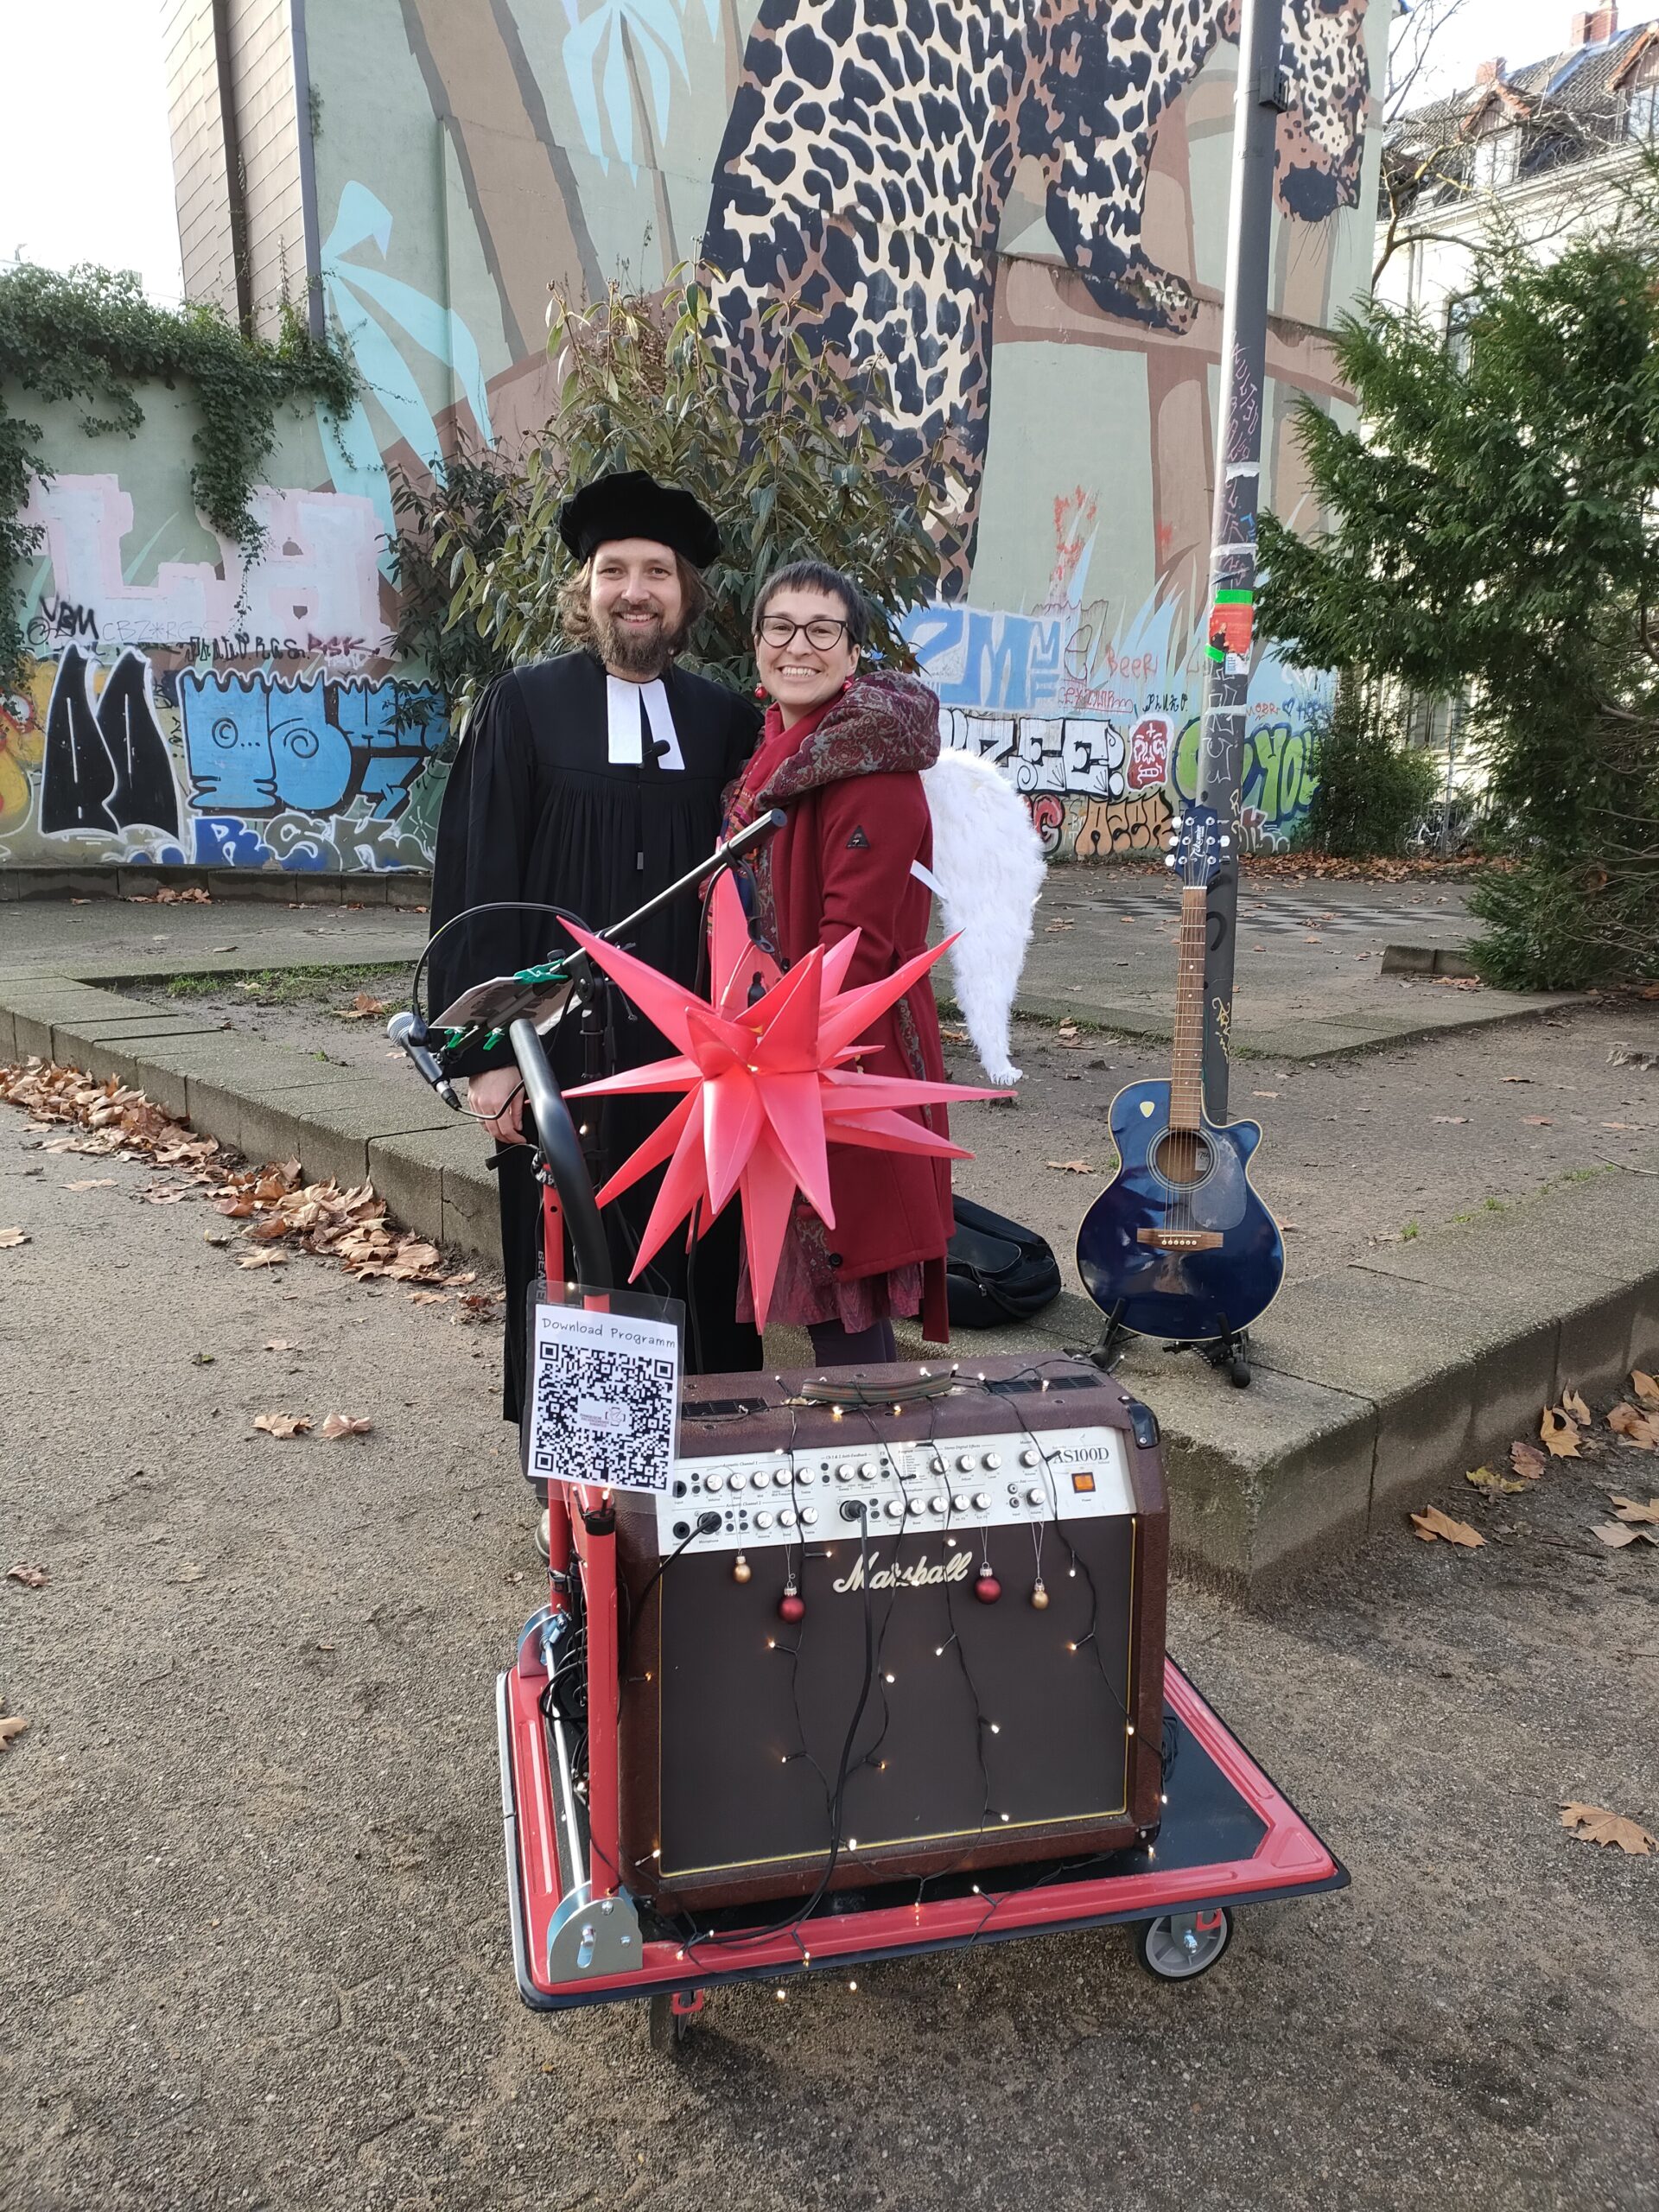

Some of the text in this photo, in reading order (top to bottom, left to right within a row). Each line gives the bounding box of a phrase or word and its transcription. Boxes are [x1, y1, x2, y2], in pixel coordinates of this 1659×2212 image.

[542, 1317, 676, 1347] Download Programm
[832, 1551, 973, 1593] Marshall
